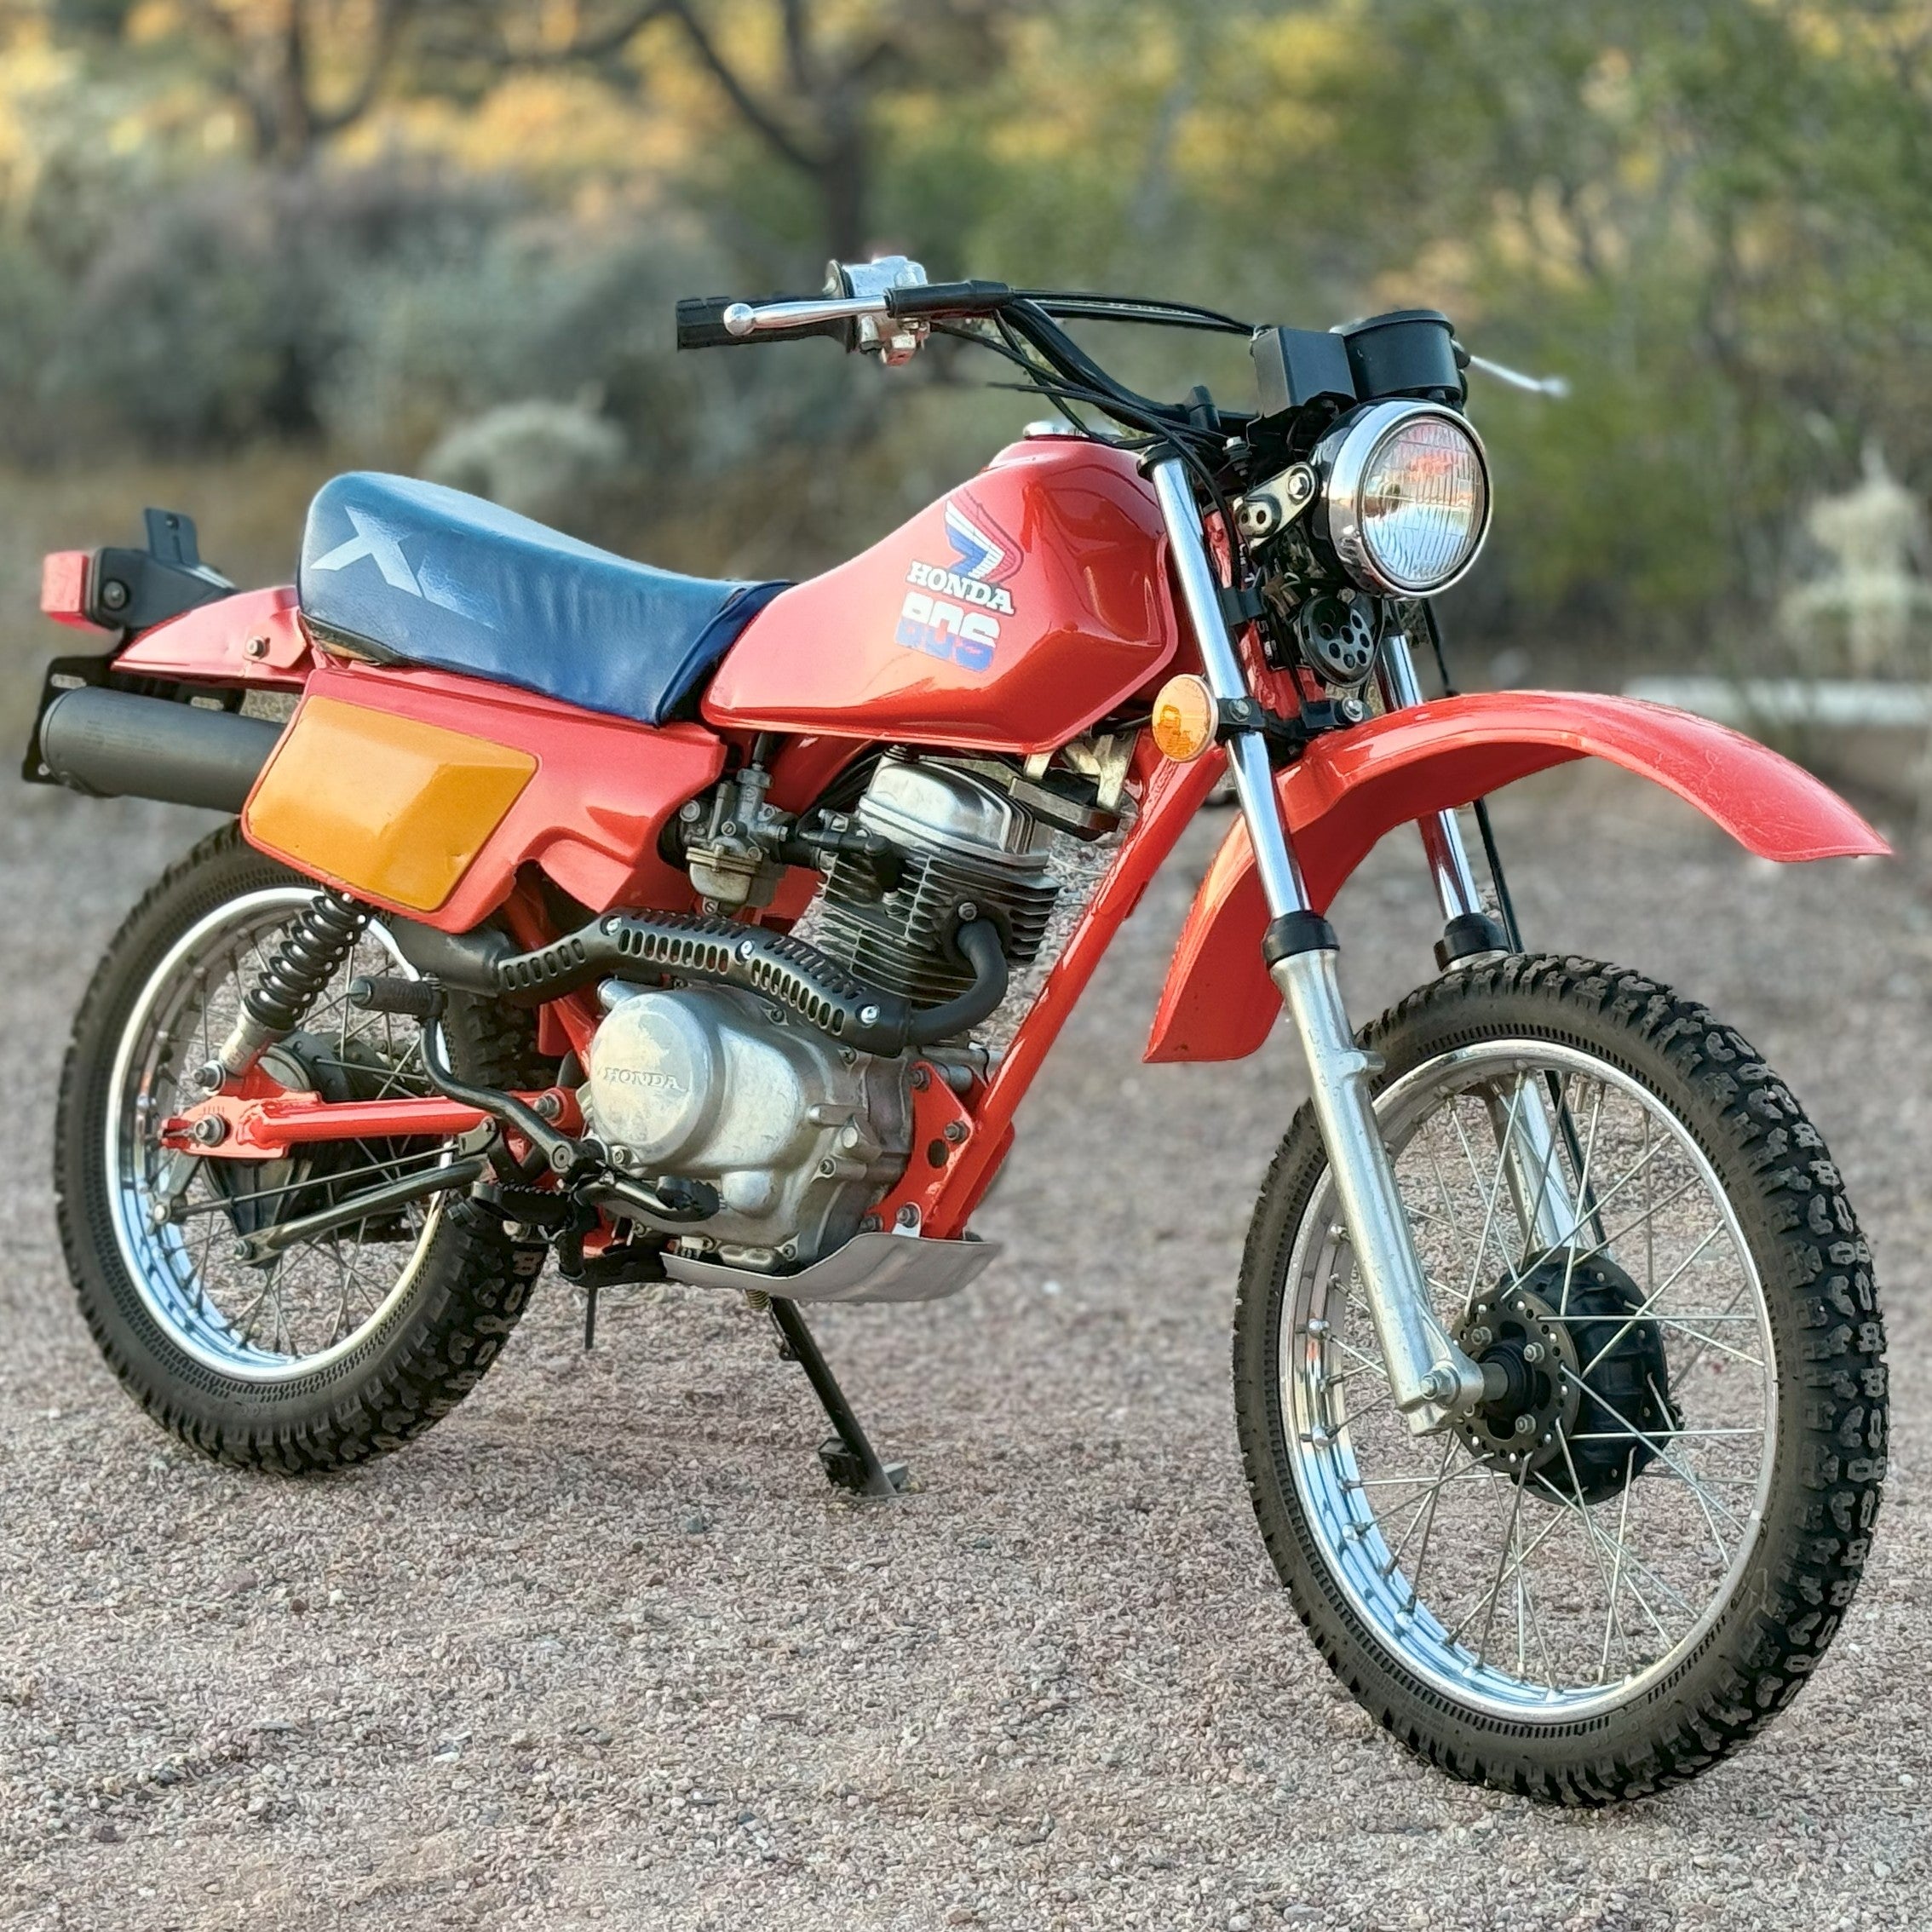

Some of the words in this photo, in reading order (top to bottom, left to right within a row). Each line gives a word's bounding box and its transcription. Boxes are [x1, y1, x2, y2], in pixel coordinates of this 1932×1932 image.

[905, 559, 1015, 617] HONDA
[895, 591, 1000, 672] 80S
[604, 1067, 688, 1093] HONDA
